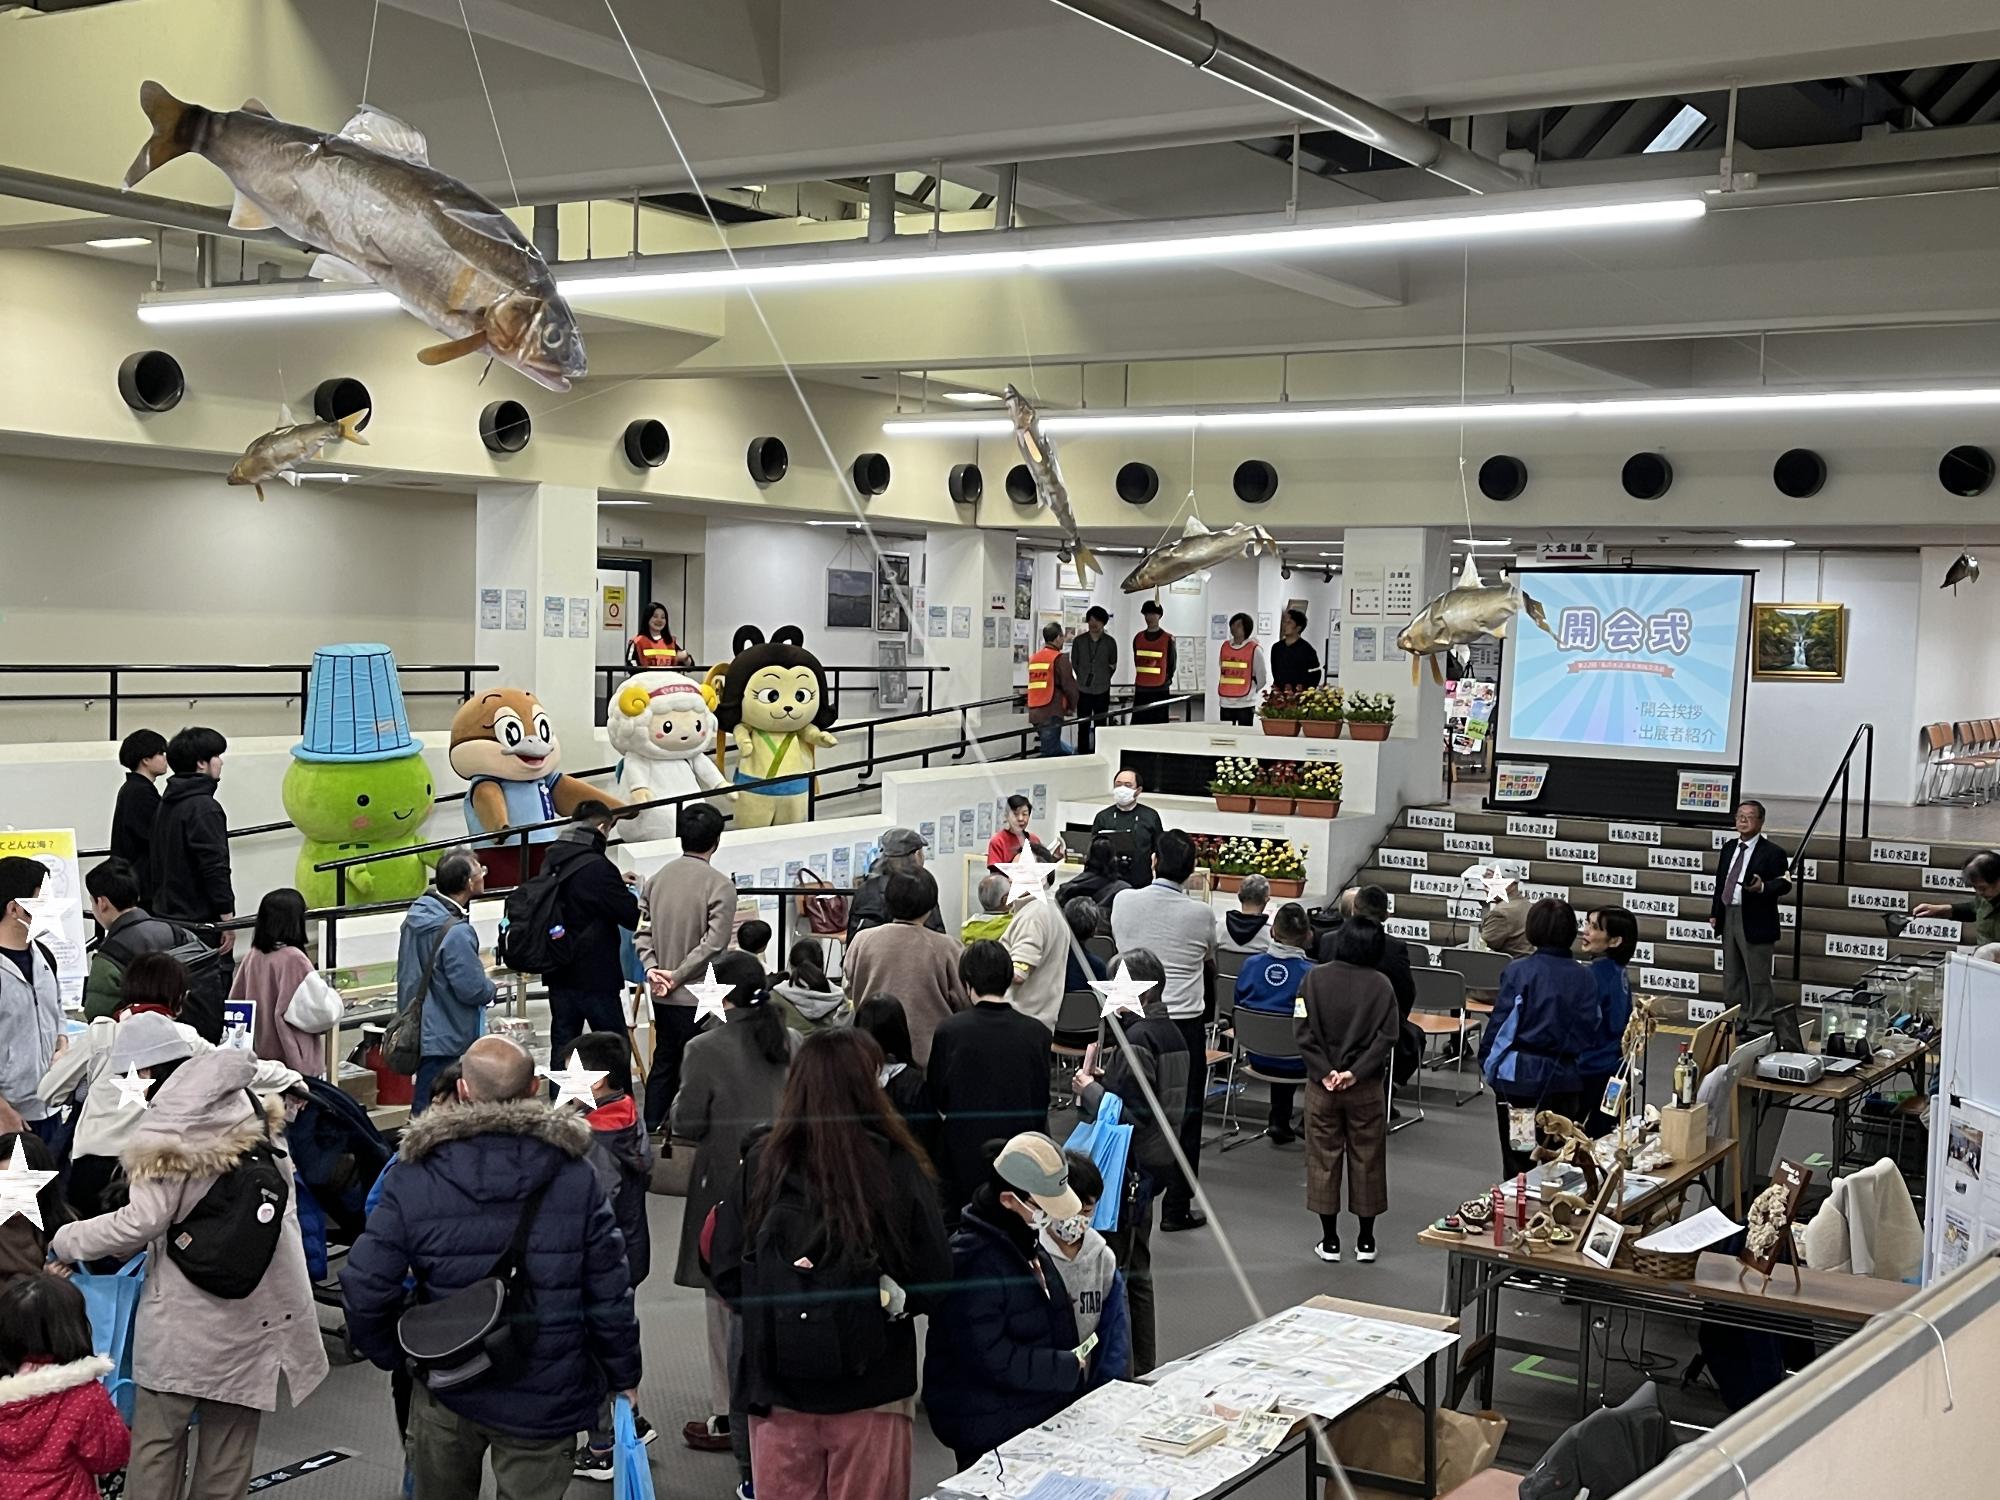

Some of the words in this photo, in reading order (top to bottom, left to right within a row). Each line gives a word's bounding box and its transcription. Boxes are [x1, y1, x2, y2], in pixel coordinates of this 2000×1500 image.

[1541, 543, 1598, 553] 大会議室
[1560, 608, 1690, 654] 開会式
[1410, 815, 1453, 829] #私の水辺泉北
[1509, 822, 1554, 835] #私の水辺泉北
[1611, 829, 1659, 842] #私の水辺泉北
[1446, 838, 1491, 851] #私の水辺泉北
[1549, 846, 1597, 860] #私の水辺泉北
[1873, 848, 1928, 863] #私の水辺泉北
[1382, 854, 1425, 868] #私の水辺泉北
[1651, 855, 1700, 868] #私の水辺泉北
[1585, 872, 1633, 886] #私の水辺泉北
[1626, 900, 1675, 913] #私の水辺泉北
[1851, 895, 1906, 909] #私の水辺泉北
[1386, 924, 1428, 937] 私の水辺泉北
[1829, 941, 1885, 956] #私の水辺泉北
[1643, 974, 1696, 989] #私の水辺泉北
